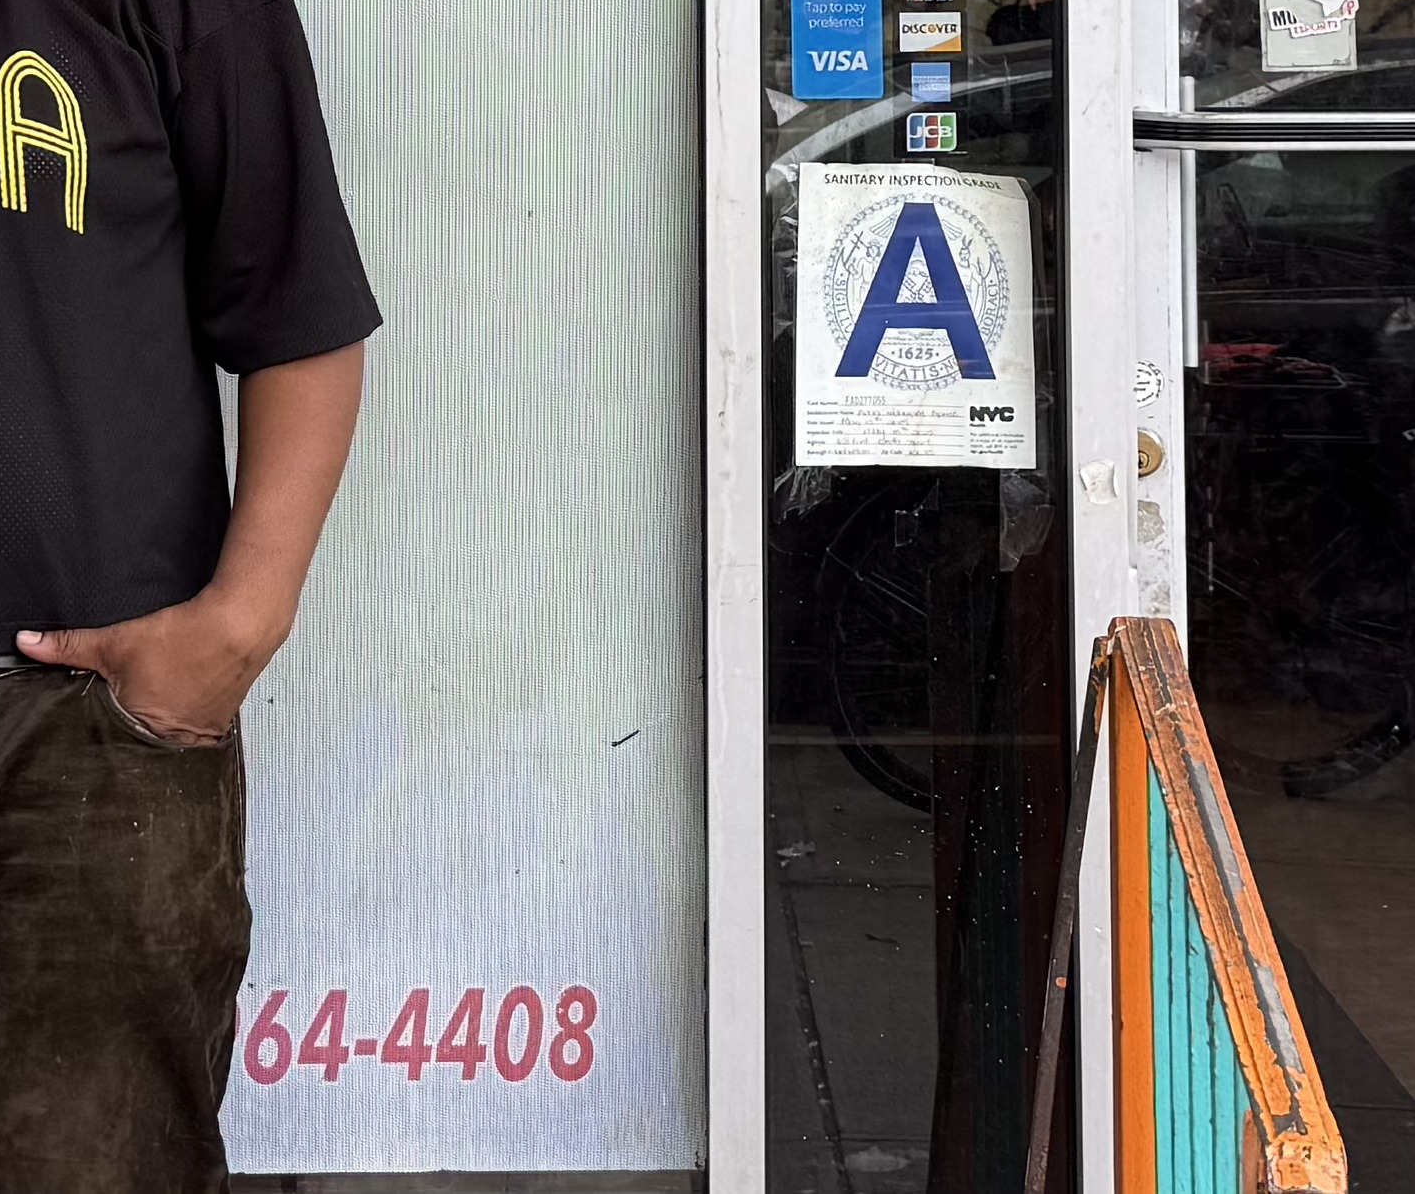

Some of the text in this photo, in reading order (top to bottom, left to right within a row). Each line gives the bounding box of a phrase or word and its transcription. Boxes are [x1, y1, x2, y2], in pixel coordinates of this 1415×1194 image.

[804, 1, 867, 15] Tap to pay
[808, 16, 864, 29] preferred
[902, 23, 958, 34] DISCOVER
[806, 50, 869, 72] VISA
[909, 125, 953, 139] JCB
[824, 173, 885, 186] SANITARY
[888, 174, 962, 187] INSPECTION
[834, 202, 997, 380] A
[897, 347, 935, 361] 1625
[969, 405, 1014, 422] NYC
[236, 984, 599, 1086] 64-4408
